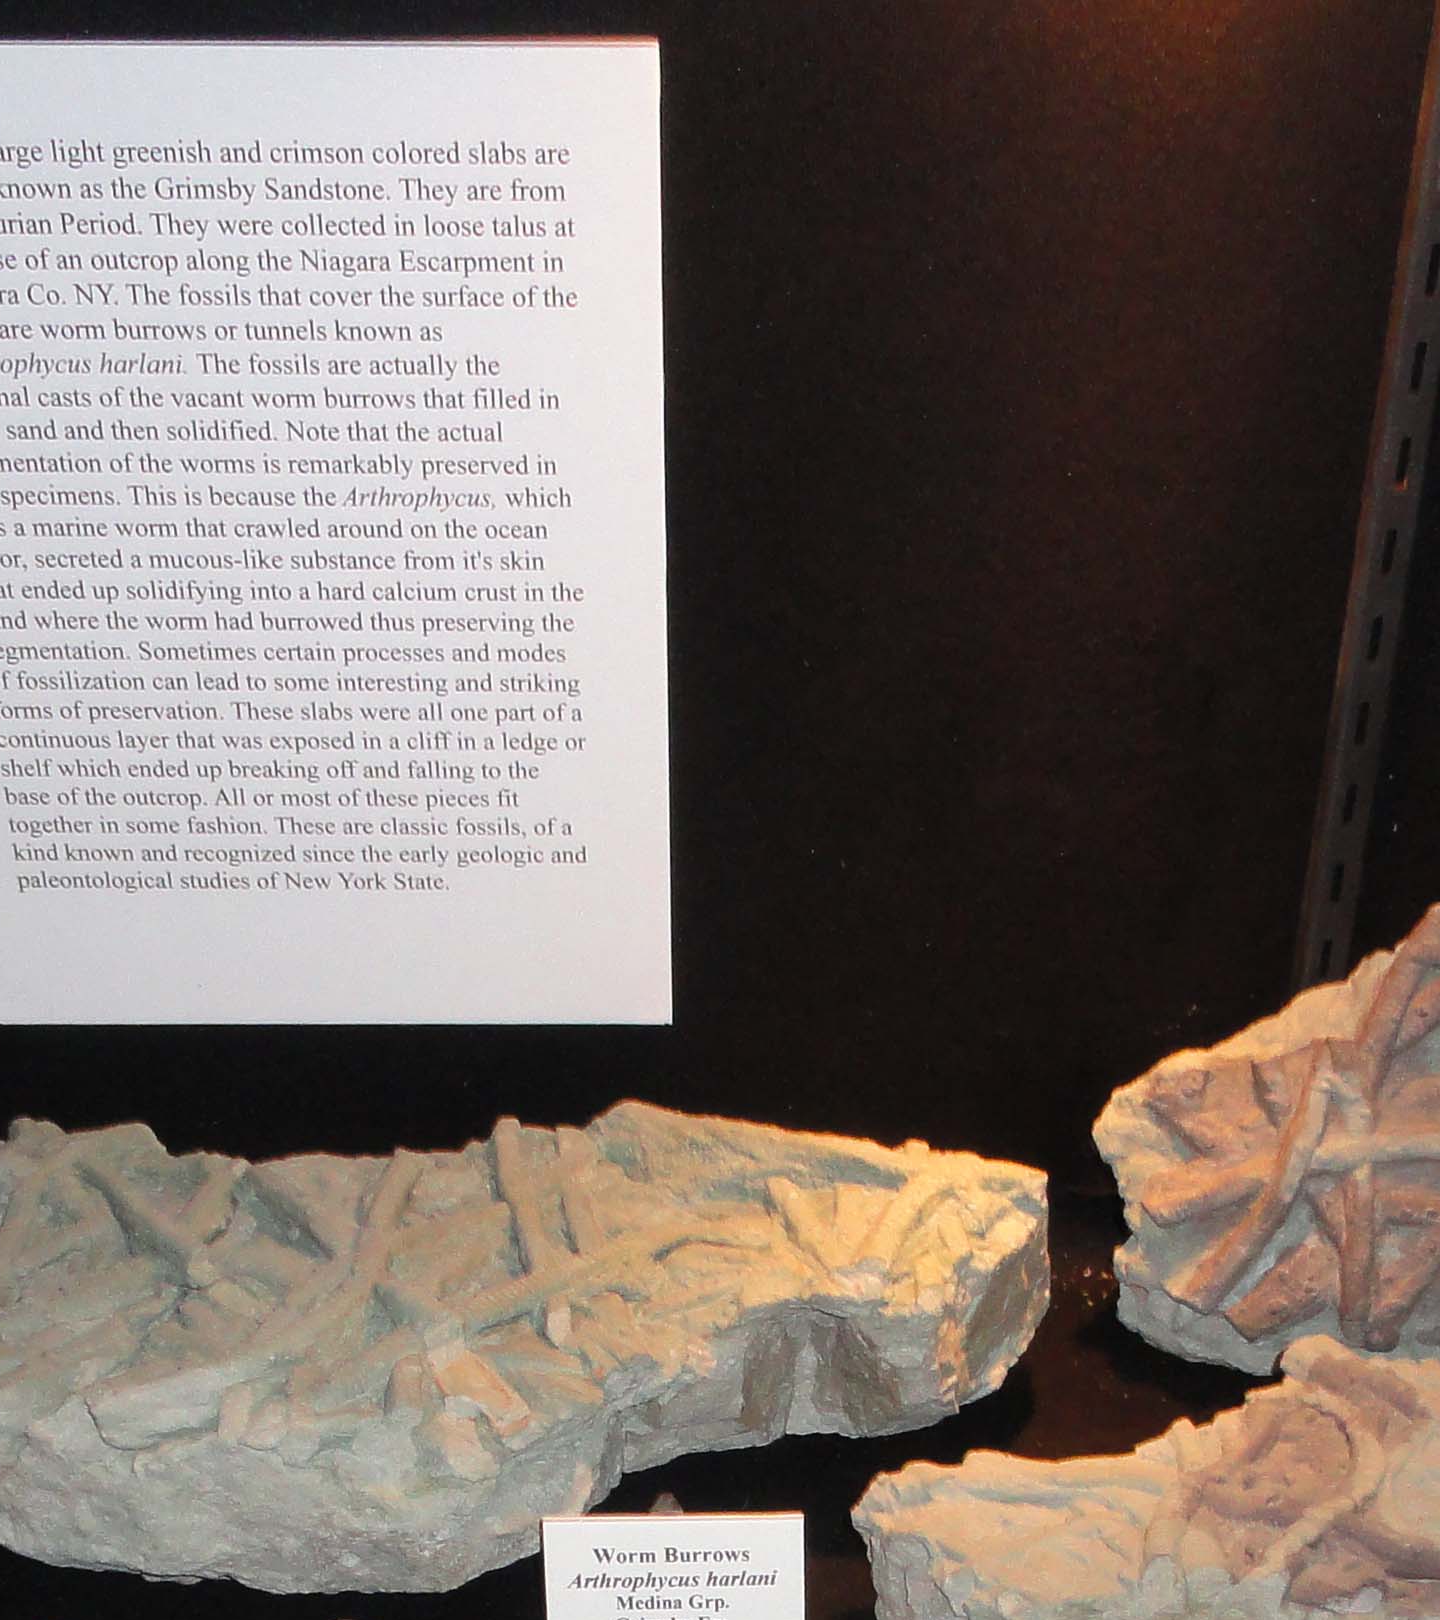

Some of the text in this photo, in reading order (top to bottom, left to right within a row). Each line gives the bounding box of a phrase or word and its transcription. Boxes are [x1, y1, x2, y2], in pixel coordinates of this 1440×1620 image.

[51, 139, 105, 169] light
[113, 139, 211, 169] greenish
[220, 140, 262, 163] and
[270, 140, 363, 164] crimson
[373, 140, 460, 164] colored
[469, 141, 526, 165] slabs
[535, 148, 569, 164] are
[60, 212, 142, 235] Period.
[149, 212, 208, 241] They
[217, 220, 273, 235] were
[282, 213, 386, 236] collected
[395, 213, 414, 236] in
[424, 214, 484, 237] loose
[492, 215, 546, 237] talus
[555, 218, 575, 237] at
[25, 248, 50, 270] of
[56, 254, 82, 270] an
[91, 252, 178, 277] outcrop
[187, 249, 250, 277] along
[257, 249, 292, 271] the
[299, 249, 390, 277] Niagara
[400, 250, 534, 278] Escarpment
[544, 250, 563, 272] in
[0, 324, 33, 339] are
[40, 324, 106, 339] worm
[112, 318, 206, 340] burrows
[215, 326, 238, 340] or
[245, 319, 327, 341] tunnels
[335, 319, 411, 341] known
[420, 326, 442, 341] as
[100, 352, 186, 374] harlani.
[196, 353, 240, 374] The
[249, 353, 320, 375] fossils
[328, 360, 361, 375] are
[370, 354, 457, 381] actually
[466, 354, 499, 376] the
[6, 419, 57, 440] sand
[65, 419, 104, 440] and
[111, 419, 159, 440] then
[167, 420, 277, 441] solidified.
[285, 421, 339, 441] Note
[347, 420, 388, 441] that
[396, 421, 429, 441] the
[438, 421, 502, 442] actual
[110, 452, 134, 473] of
[139, 453, 172, 473] the
[180, 459, 255, 473] worms
[263, 453, 280, 473] is
[288, 454, 412, 480] remarkably
[421, 454, 528, 480] preserved
[538, 454, 556, 475] in
[1, 484, 120, 510] specimens.
[127, 485, 176, 505] This
[185, 485, 202, 505] is
[208, 485, 296, 506] because
[303, 486, 336, 506] the
[343, 486, 495, 512] Arthrophycus,
[505, 487, 571, 507] which
[35, 549, 123, 568] secreted
[131, 555, 142, 568] a
[149, 549, 283, 569] mucous-like
[291, 549, 395, 570] substance
[404, 550, 454, 570] from
[463, 551, 492, 570] it's
[501, 550, 544, 570] skin
[34, 610, 99, 629] where
[106, 611, 138, 630] the
[145, 616, 207, 630] worm
[214, 611, 253, 630] had
[260, 611, 363, 631] burrowed
[370, 612, 415, 631] thus
[422, 612, 535, 637] preserving
[542, 613, 573, 632] the
[139, 641, 256, 660] Sometimes
[264, 642, 335, 661] certain
[342, 648, 444, 666] processes
[452, 643, 489, 662] and
[498, 643, 566, 662] modes
[16, 670, 145, 690] fossilization
[153, 677, 188, 690] can
[196, 672, 239, 691] lead
[246, 675, 266, 690] to
[274, 678, 329, 691] some
[337, 672, 448, 696] interesting
[456, 672, 492, 692] and
[500, 673, 580, 697] striking
[1, 759, 539, 783] shelf which ended up breaking off and falling to the
[9, 816, 572, 838] together in some fashion. These are classic fossils, of a
[12, 843, 586, 868] kind known and recognized since the early geologic and
[17, 871, 449, 893] paleontological studies of New York State.
[593, 1548, 749, 1563] Worm Burrows
[568, 1570, 777, 1592] Arthrophycus harlani
[617, 1595, 729, 1612] Medina Grp.
